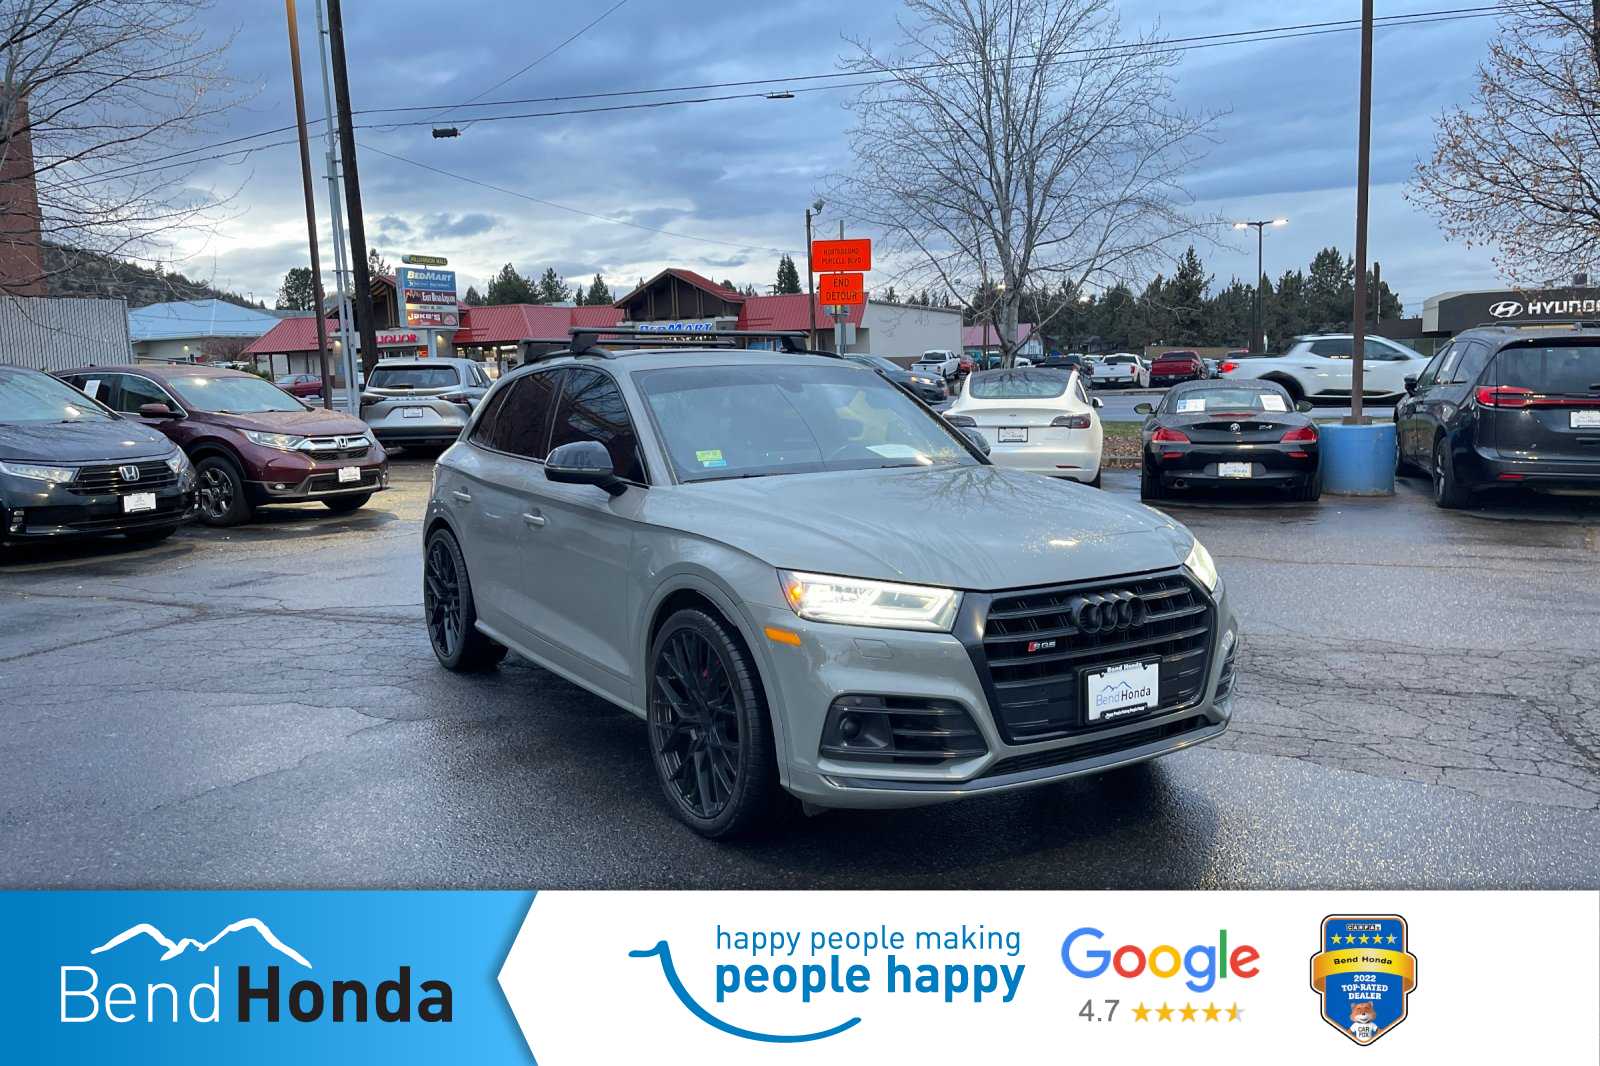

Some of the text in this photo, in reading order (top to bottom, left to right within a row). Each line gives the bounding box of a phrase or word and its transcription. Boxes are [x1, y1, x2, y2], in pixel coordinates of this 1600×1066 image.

[833, 278, 850, 287] END
[826, 291, 857, 301] DETOUR
[1096, 686, 1151, 706] Bend Honda
